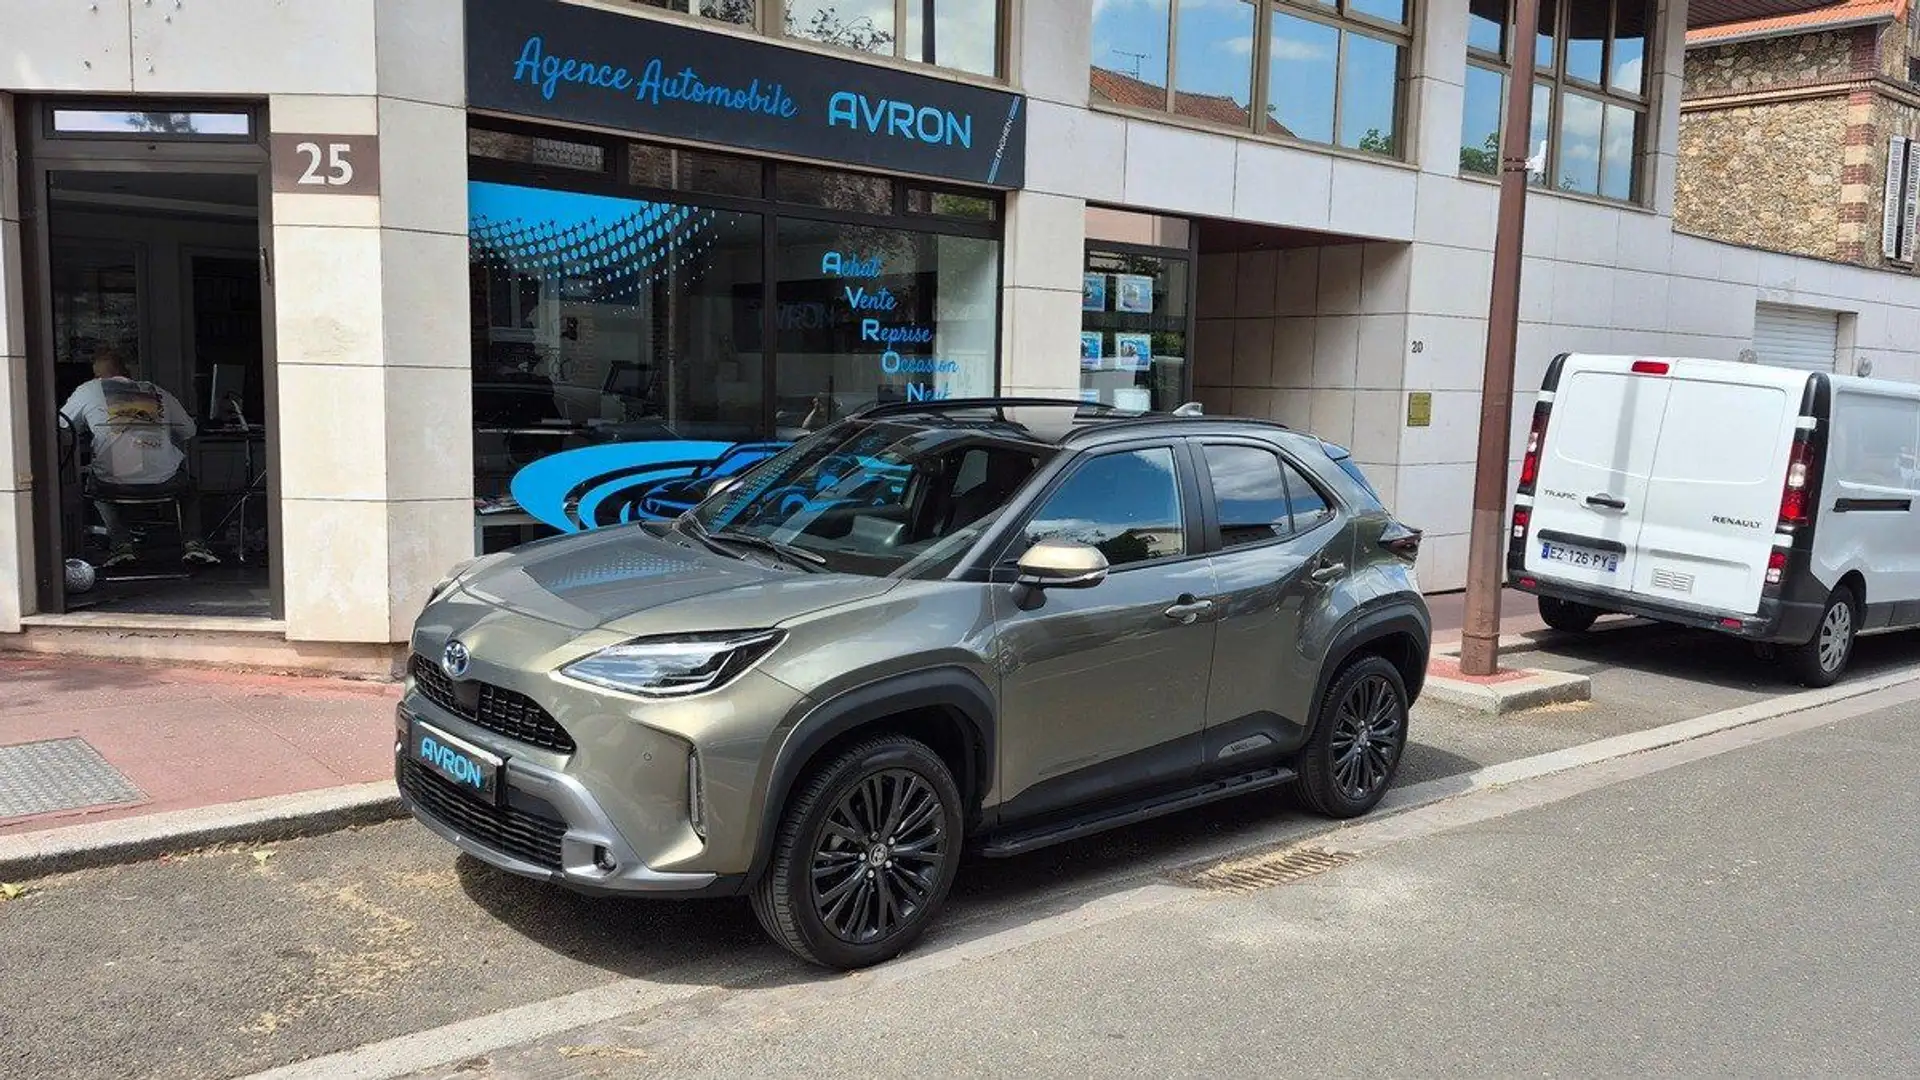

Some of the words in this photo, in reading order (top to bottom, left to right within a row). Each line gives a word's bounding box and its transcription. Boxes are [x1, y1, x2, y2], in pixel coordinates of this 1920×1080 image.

[514, 36, 633, 99] Agence
[637, 58, 798, 118] Automobile
[828, 91, 971, 149] AVRON
[296, 142, 353, 185] 25
[822, 251, 882, 278] Achat
[845, 286, 898, 310] Vente
[862, 318, 933, 350] Reprise
[1411, 341, 1424, 353] 20
[882, 351, 959, 373] Occasion
[1544, 489, 1577, 500] TRAFIC
[1712, 515, 1761, 529] RENAULT
[421, 737, 481, 789] AVRON
